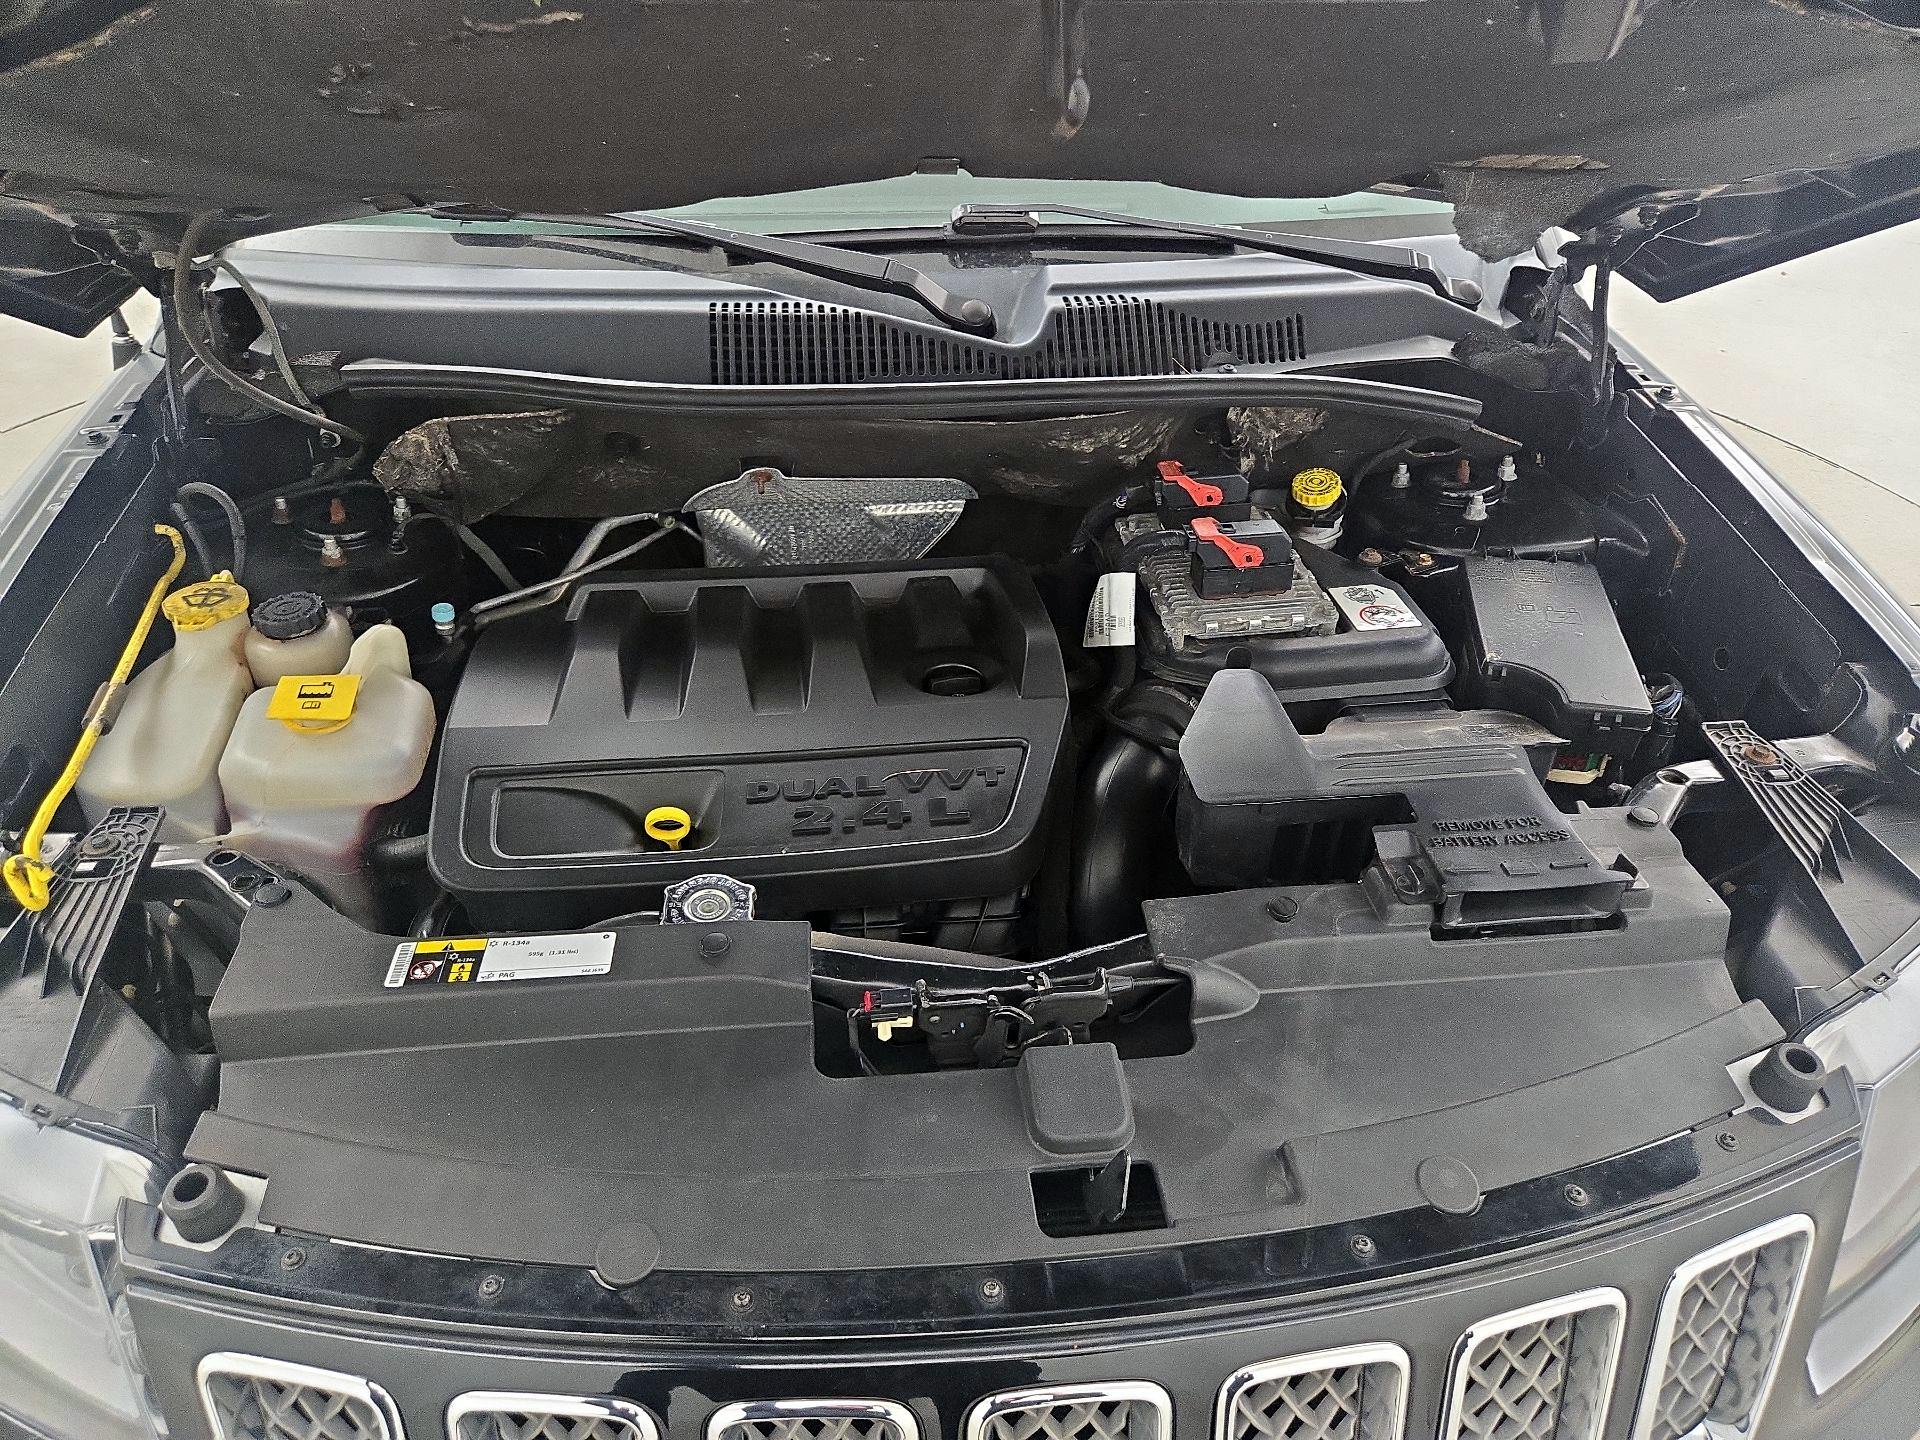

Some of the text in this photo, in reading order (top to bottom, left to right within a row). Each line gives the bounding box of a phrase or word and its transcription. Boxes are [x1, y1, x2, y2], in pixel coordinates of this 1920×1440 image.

[746, 764, 1006, 804] DUAL VVT
[791, 796, 971, 836] 2.4 L
[1433, 815, 1543, 833] REMOVE FOR
[1430, 828, 1571, 848] BATTERY ACCESS
